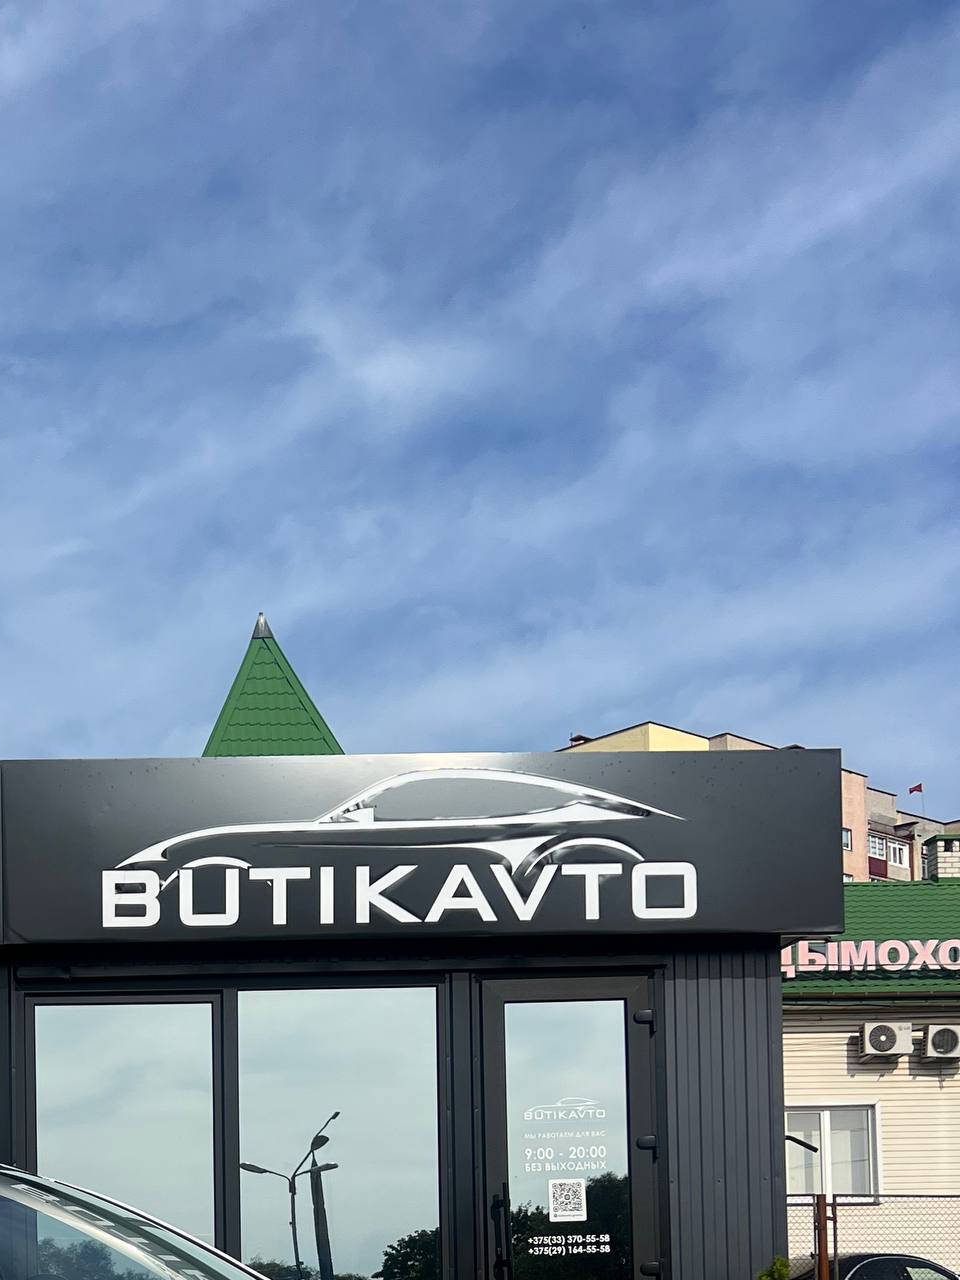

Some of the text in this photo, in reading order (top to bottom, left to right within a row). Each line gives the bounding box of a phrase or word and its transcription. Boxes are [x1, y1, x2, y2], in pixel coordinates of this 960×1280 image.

[101, 861, 698, 928] BUTIKAVTO
[523, 1109, 606, 1120] BUTIKAVTO
[538, 1131, 574, 1139] РАБОТАЕМ
[525, 1147, 554, 1160] 9:00
[568, 1145, 607, 1158] 20:00
[525, 1160, 607, 1172] БЕЗ ВЫХОДНЫХ
[527, 1234, 610, 1245] +375(33) 370-55-58
[528, 1245, 611, 1256] +375(29) 164-55-58
